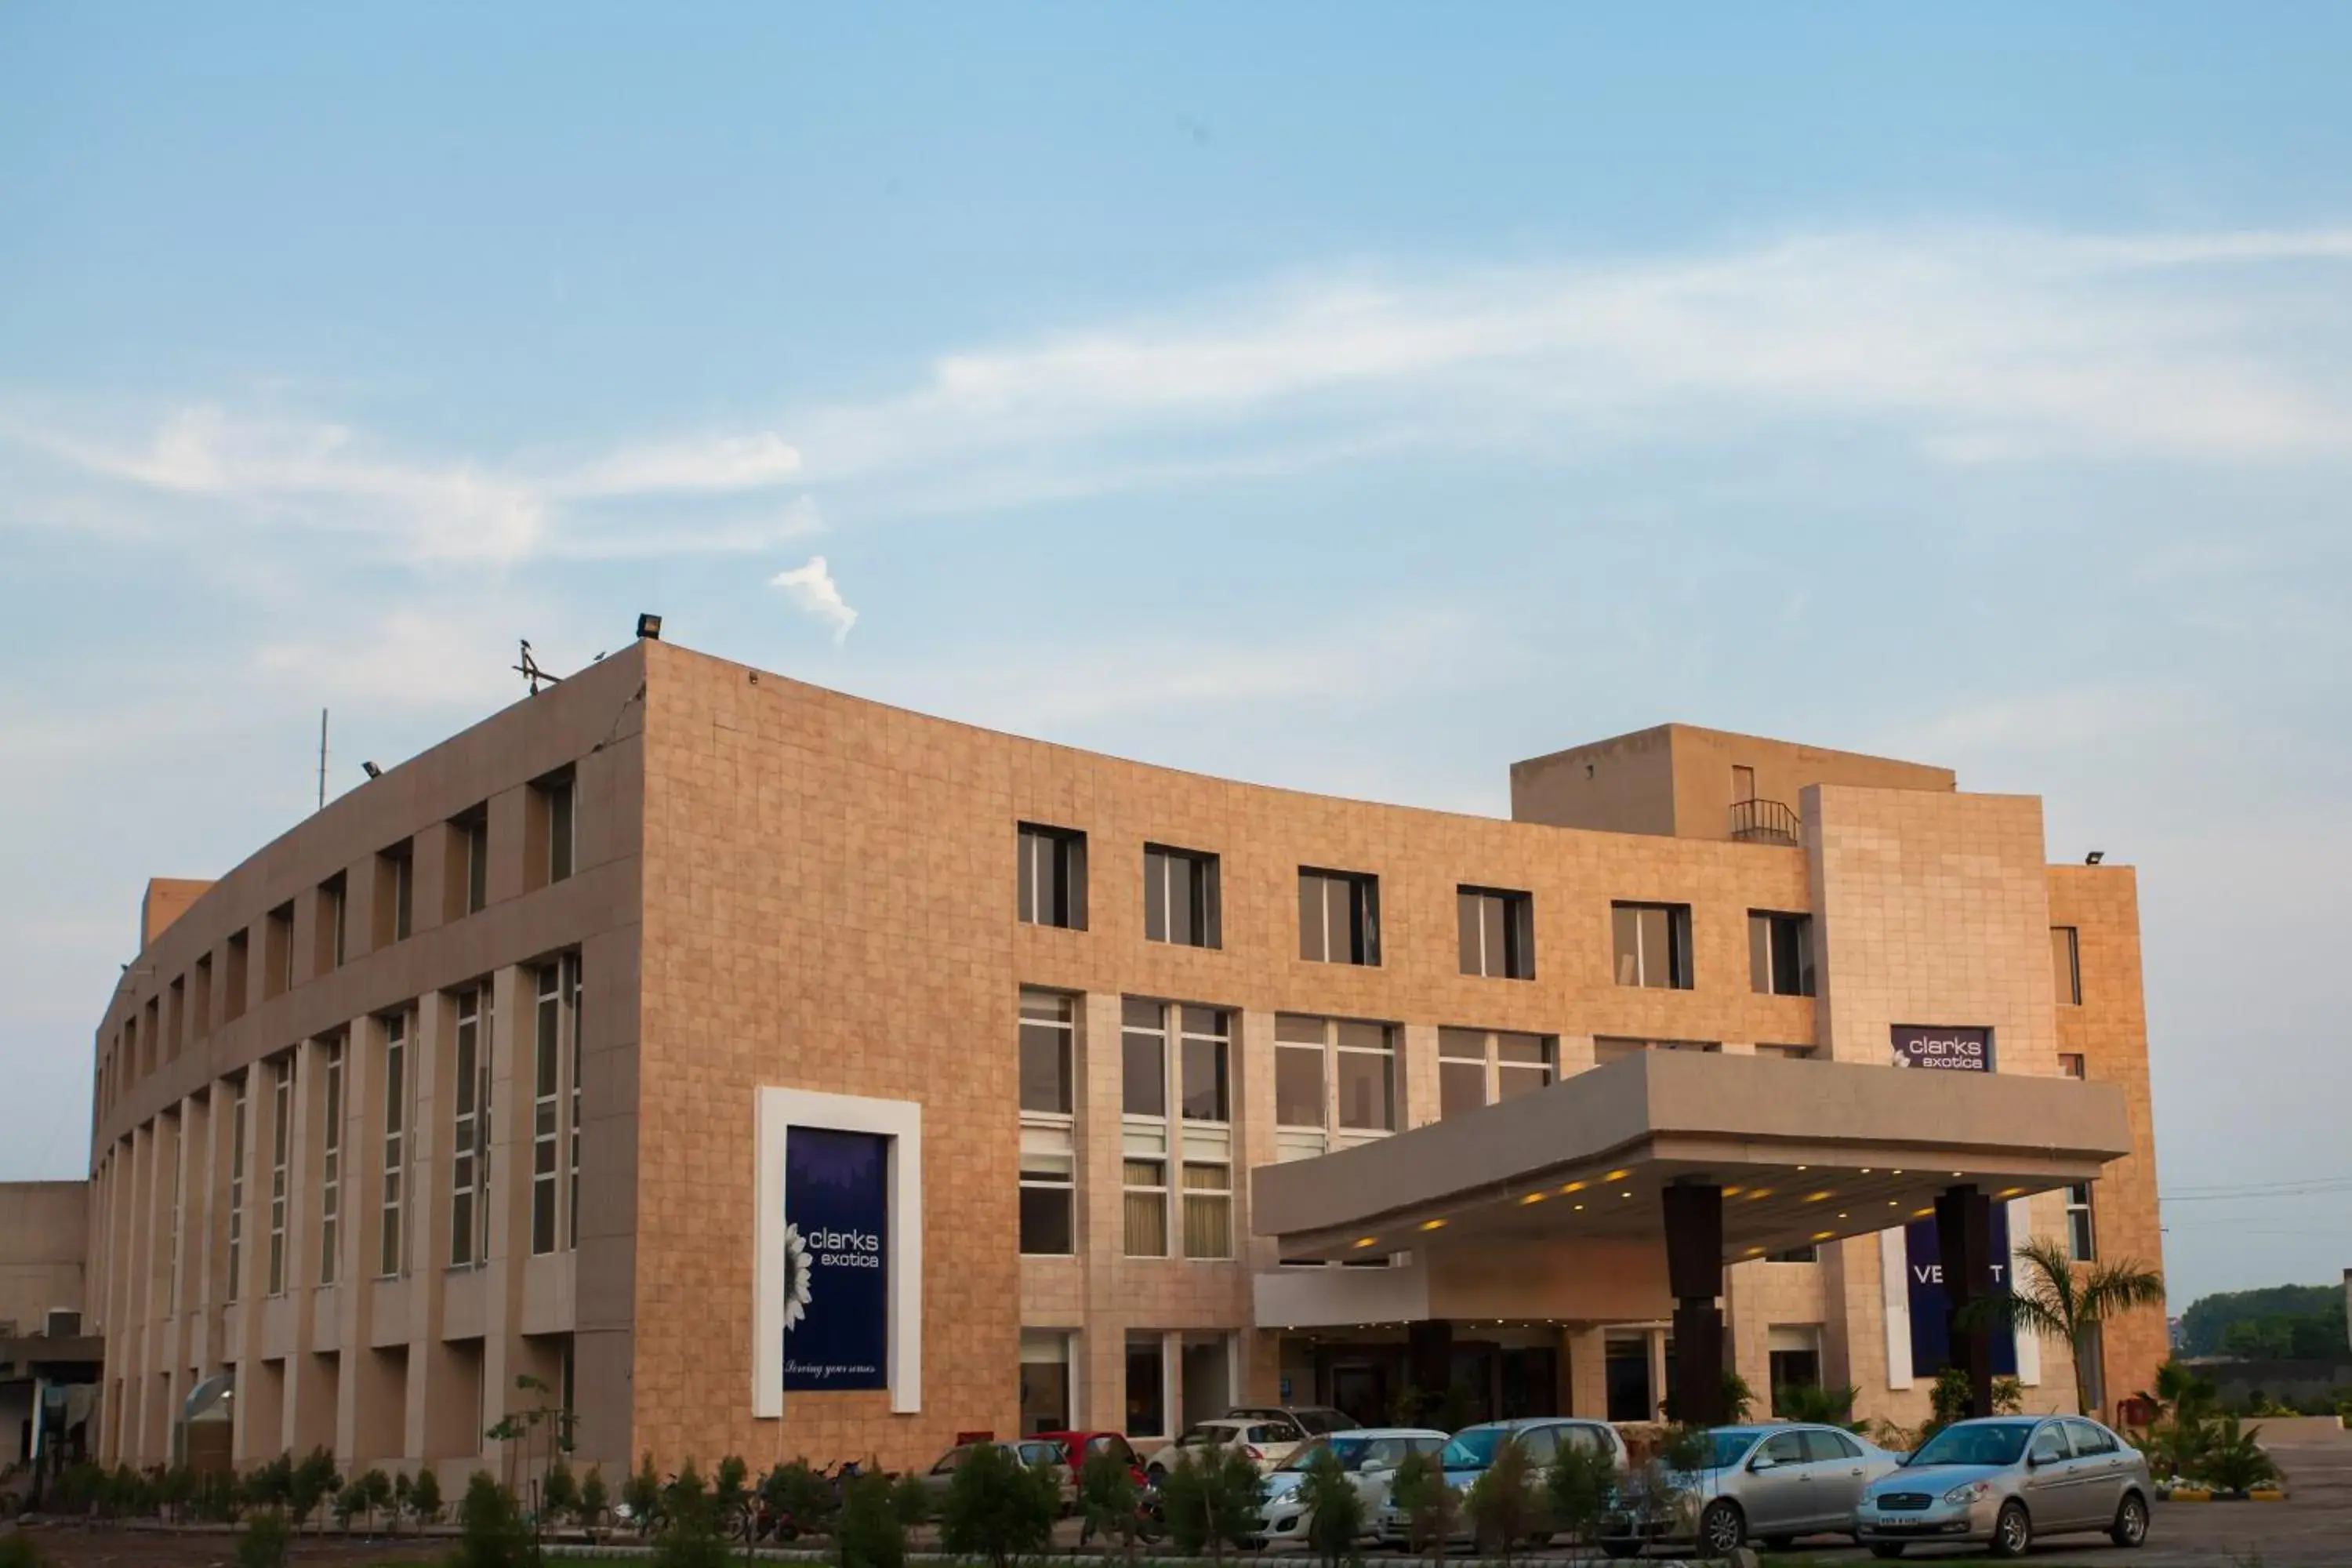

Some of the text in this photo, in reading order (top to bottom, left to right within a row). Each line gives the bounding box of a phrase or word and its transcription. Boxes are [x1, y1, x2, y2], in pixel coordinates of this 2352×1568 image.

[1909, 1036, 1982, 1055] clarks
[1923, 1056, 1983, 1069] exotica
[809, 1227, 878, 1251] clarks
[821, 1252, 878, 1268] exotica
